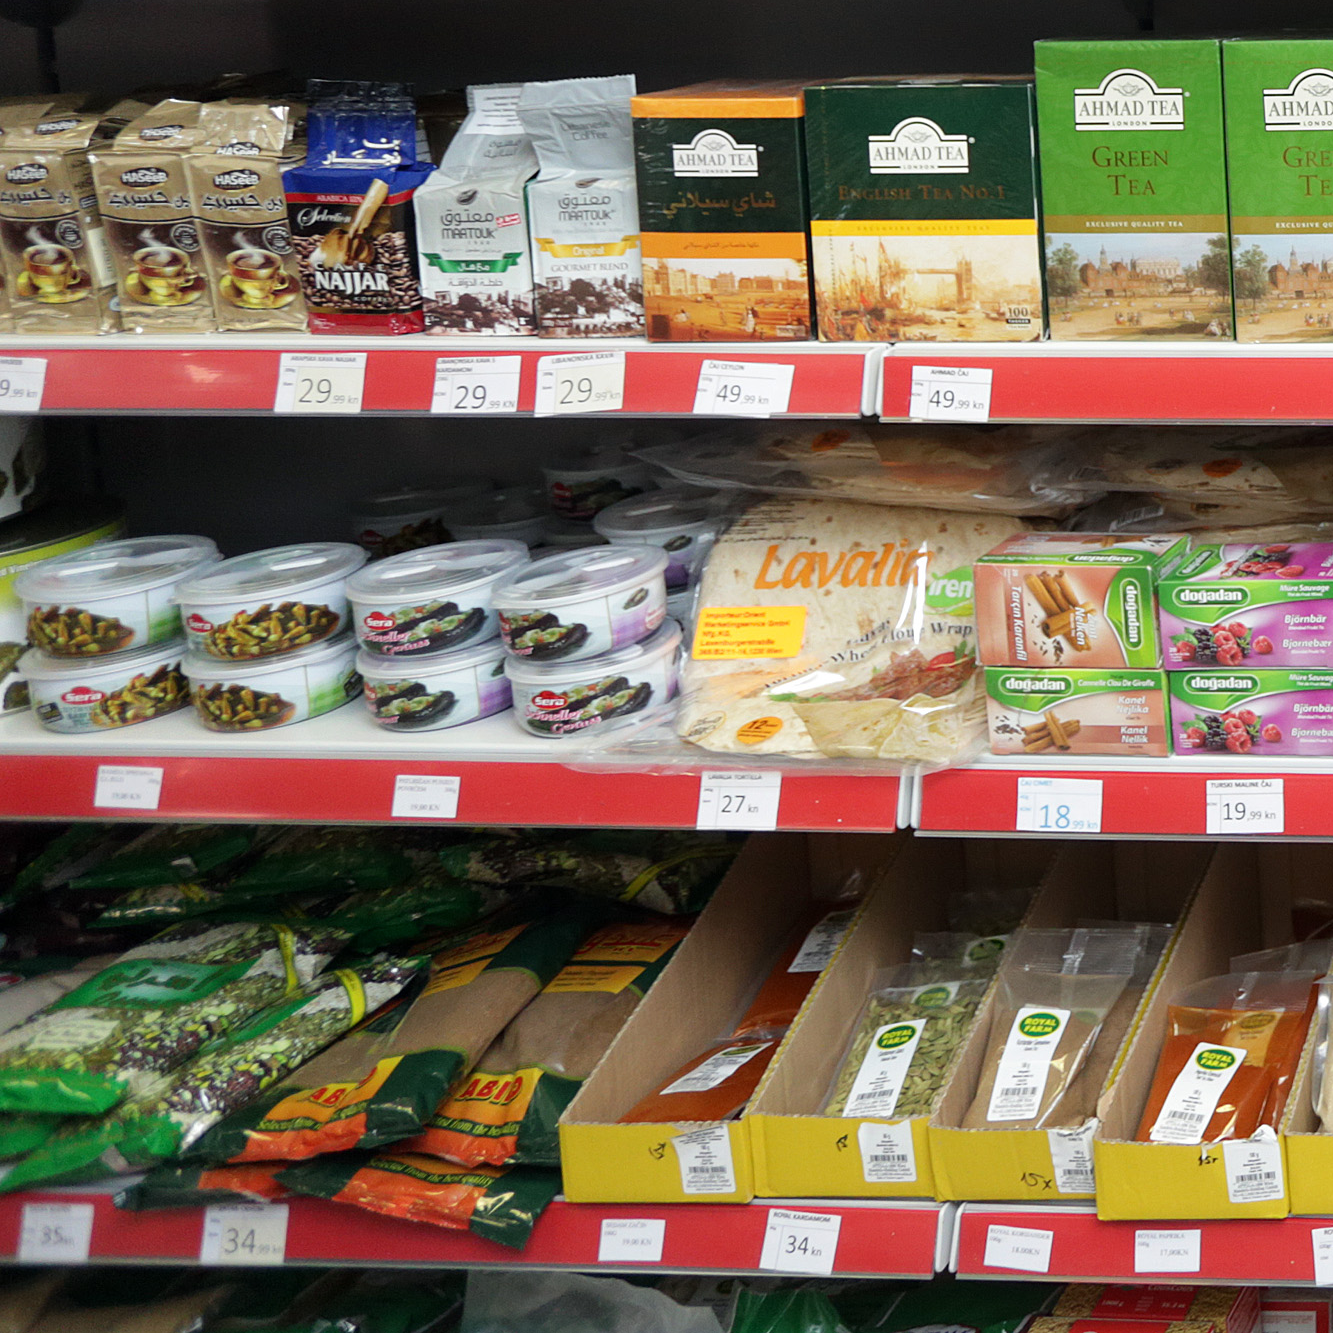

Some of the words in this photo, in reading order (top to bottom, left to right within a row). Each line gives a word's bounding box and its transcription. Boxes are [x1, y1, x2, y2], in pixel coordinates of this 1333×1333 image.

[1078, 101, 1143, 118] AHMAD
[1146, 99, 1181, 115] TEA
[1092, 146, 1169, 169] GREEN
[838, 185, 912, 200] ENGLISH
[918, 185, 954, 200] TEA
[1107, 175, 1156, 196] TEA
[551, 263, 596, 273] GOURMET
[600, 261, 629, 270] BLEND
[315, 270, 389, 293] NAJJAR
[1284, 614, 1327, 626] Björnbär
[1211, 781, 1232, 789] TURSKI
[721, 796, 745, 813] 27
[748, 804, 758, 813] kn
[785, 1236, 808, 1254] 34
[811, 1246, 822, 1256] kn
